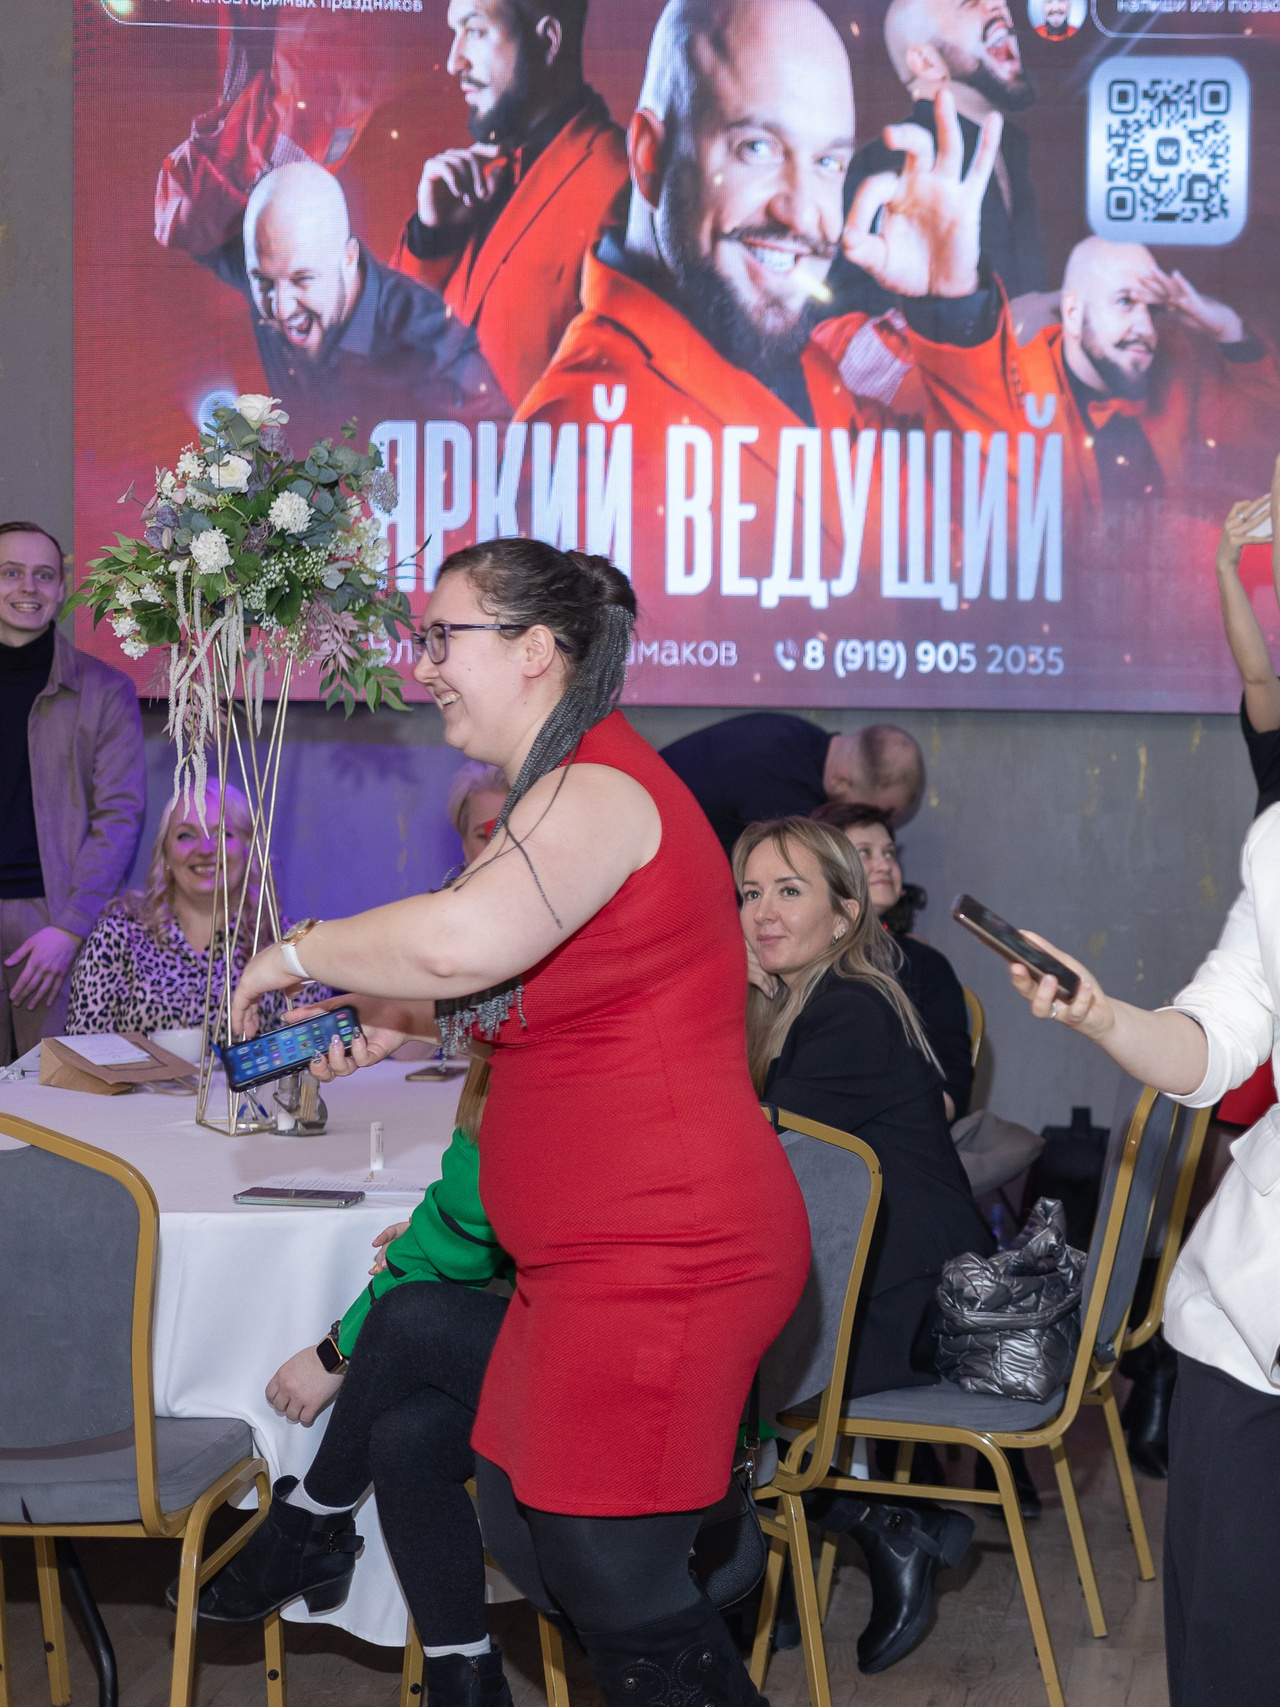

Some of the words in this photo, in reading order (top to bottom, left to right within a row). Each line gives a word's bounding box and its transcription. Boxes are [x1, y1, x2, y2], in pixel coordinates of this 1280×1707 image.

[321, 0, 424, 13] праздников
[369, 384, 633, 593] ЯРКИЙ
[665, 394, 1063, 612] ВЕДУЩИЙ
[802, 637, 825, 671] 8
[833, 638, 907, 680] (919)
[915, 640, 977, 674] 905
[986, 643, 1065, 676] 2035
